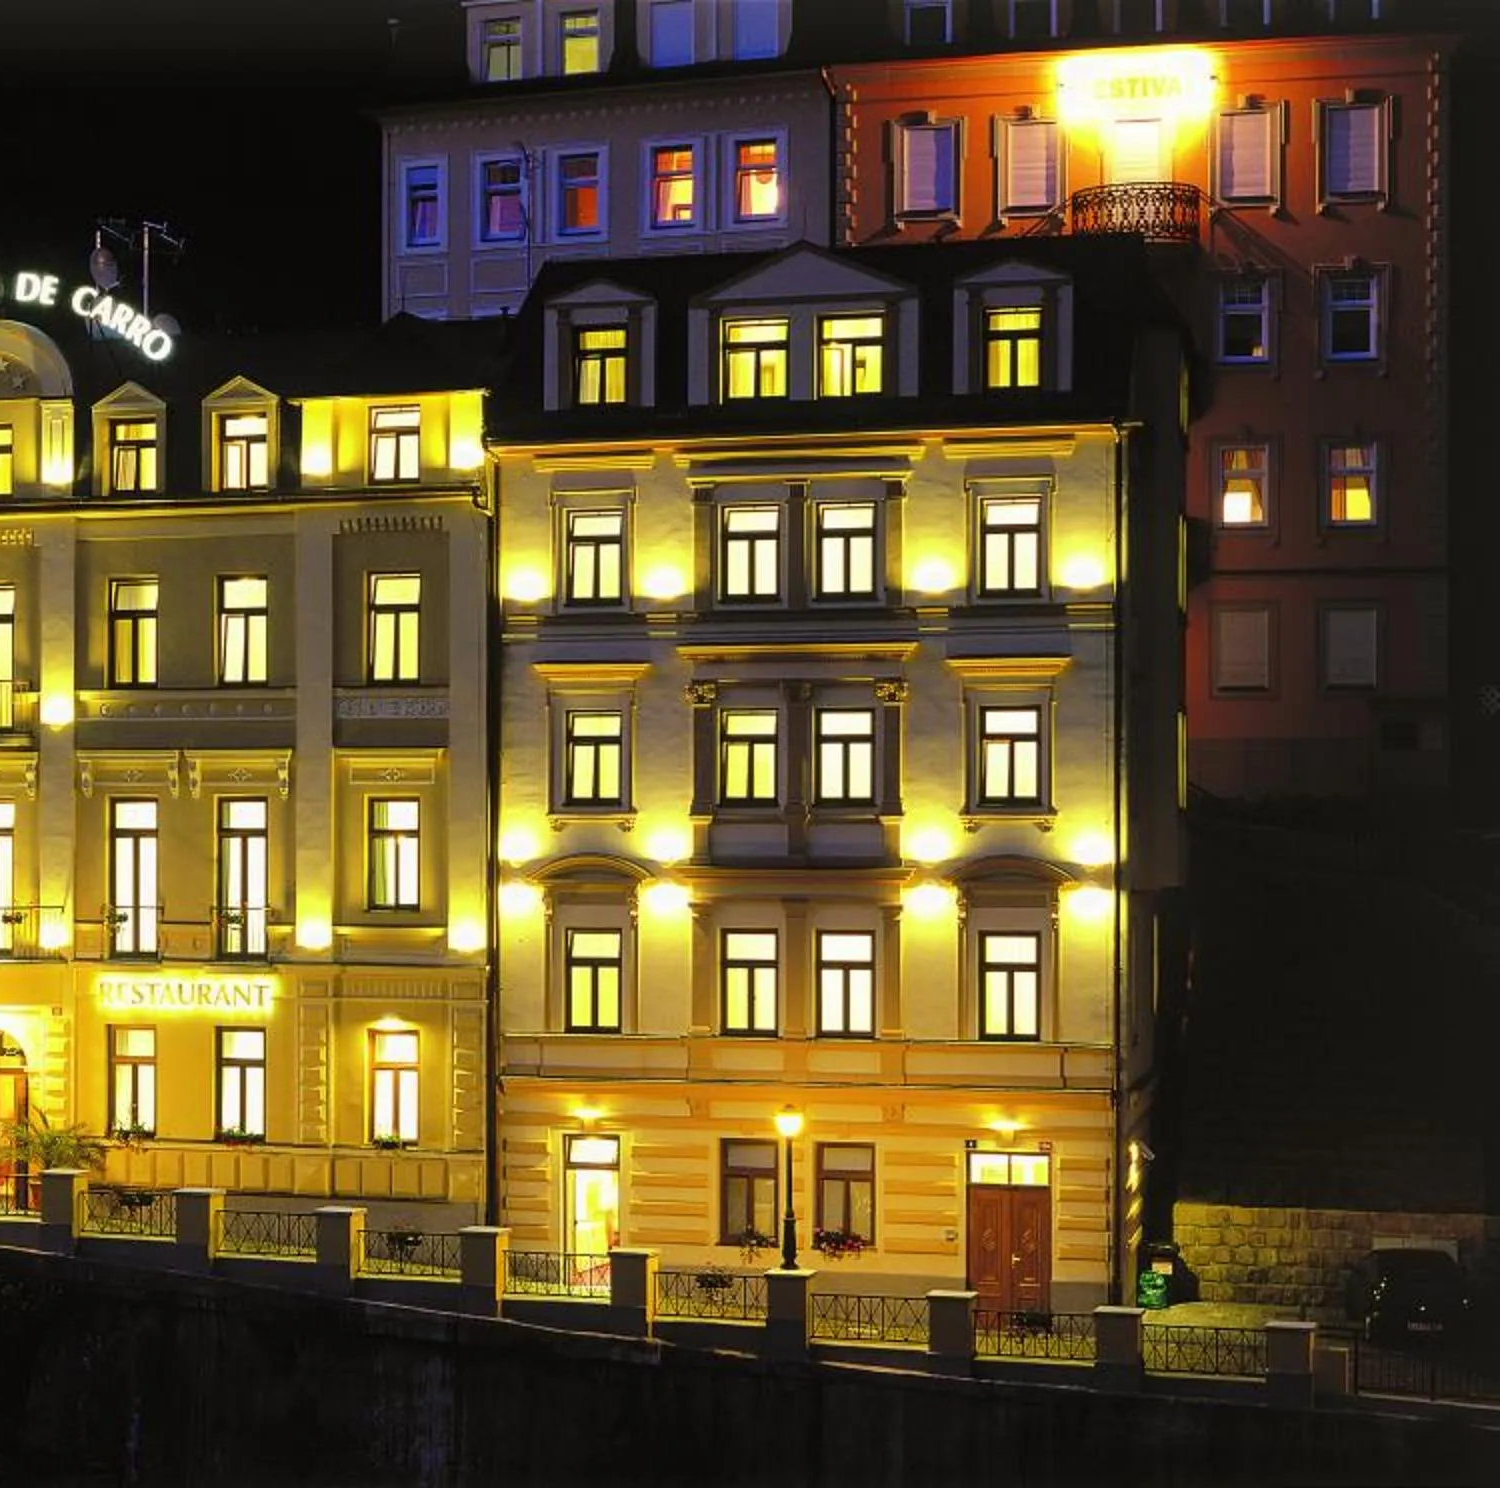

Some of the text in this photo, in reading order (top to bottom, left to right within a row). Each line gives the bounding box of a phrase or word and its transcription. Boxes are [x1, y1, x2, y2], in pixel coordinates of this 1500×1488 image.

[1086, 75, 1194, 100] ESTIVA
[15, 272, 60, 306] DE
[71, 285, 174, 362] CARRO
[99, 981, 271, 1007] RESTAURANT
